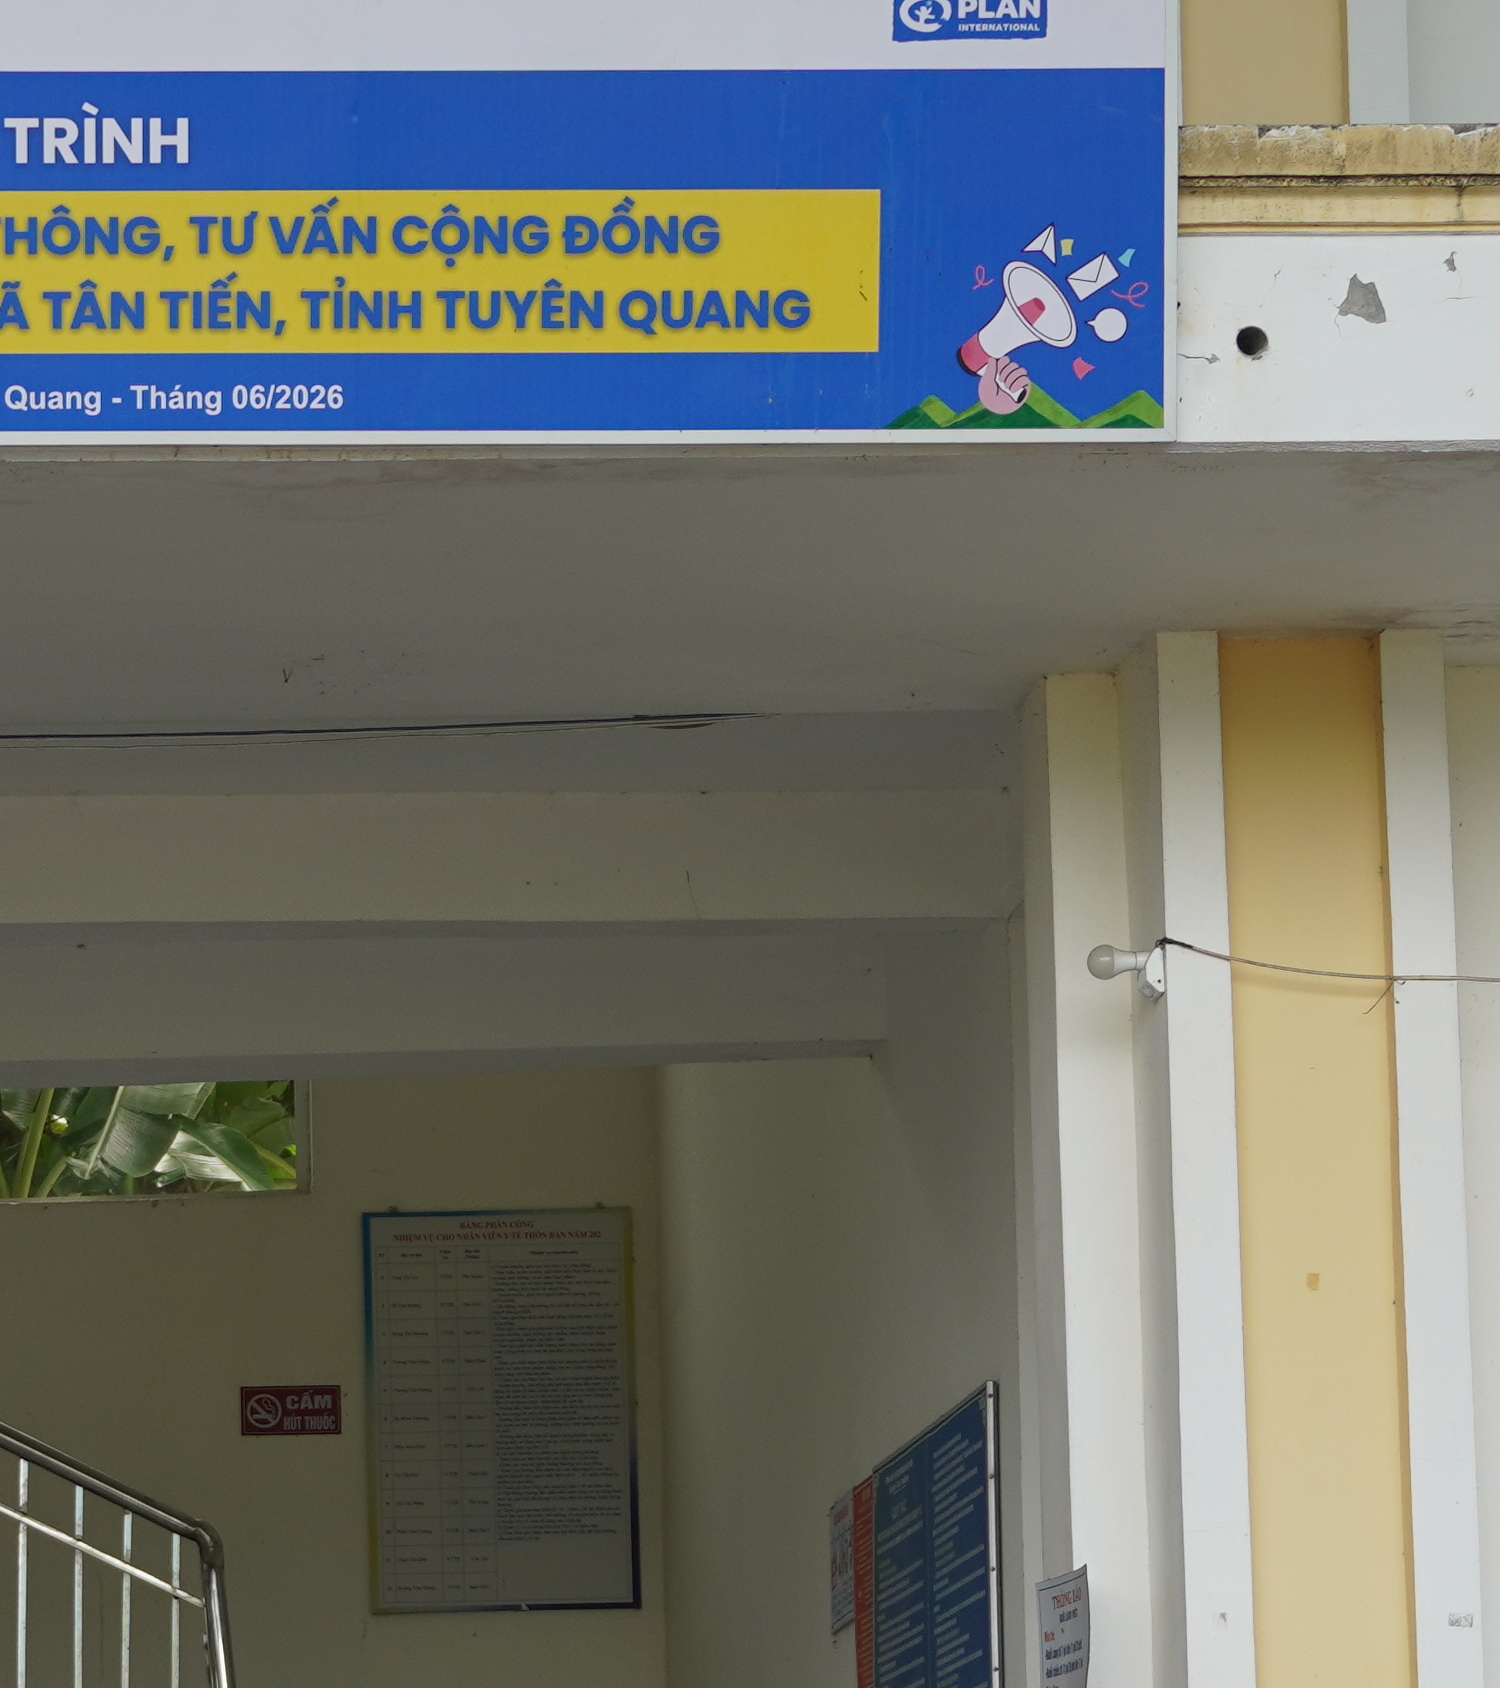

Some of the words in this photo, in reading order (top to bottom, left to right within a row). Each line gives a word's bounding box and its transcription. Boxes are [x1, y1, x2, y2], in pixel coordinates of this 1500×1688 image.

[957, 0, 1041, 19] PLAN
[957, 22, 1041, 32] INTERNATIONAL
[4, 102, 188, 163] TRÌNH
[189, 211, 258, 255] TƯ
[269, 197, 377, 255] VẤN
[392, 204, 550, 267] CỘNG
[562, 196, 720, 255] ĐỒNG
[42, 279, 145, 330] TÂN
[164, 272, 286, 336] TIẾN,
[300, 276, 422, 329] TỈNH
[436, 278, 604, 329] TUYÊN
[618, 290, 810, 335] QUANG
[5, 385, 101, 416] Quang
[130, 385, 221, 415] Tháng
[233, 385, 343, 409] 06/2026
[286, 1389, 333, 1410] CẤM
[283, 1412, 303, 1431] HÚT
[304, 1411, 336, 1430] THUỐC
